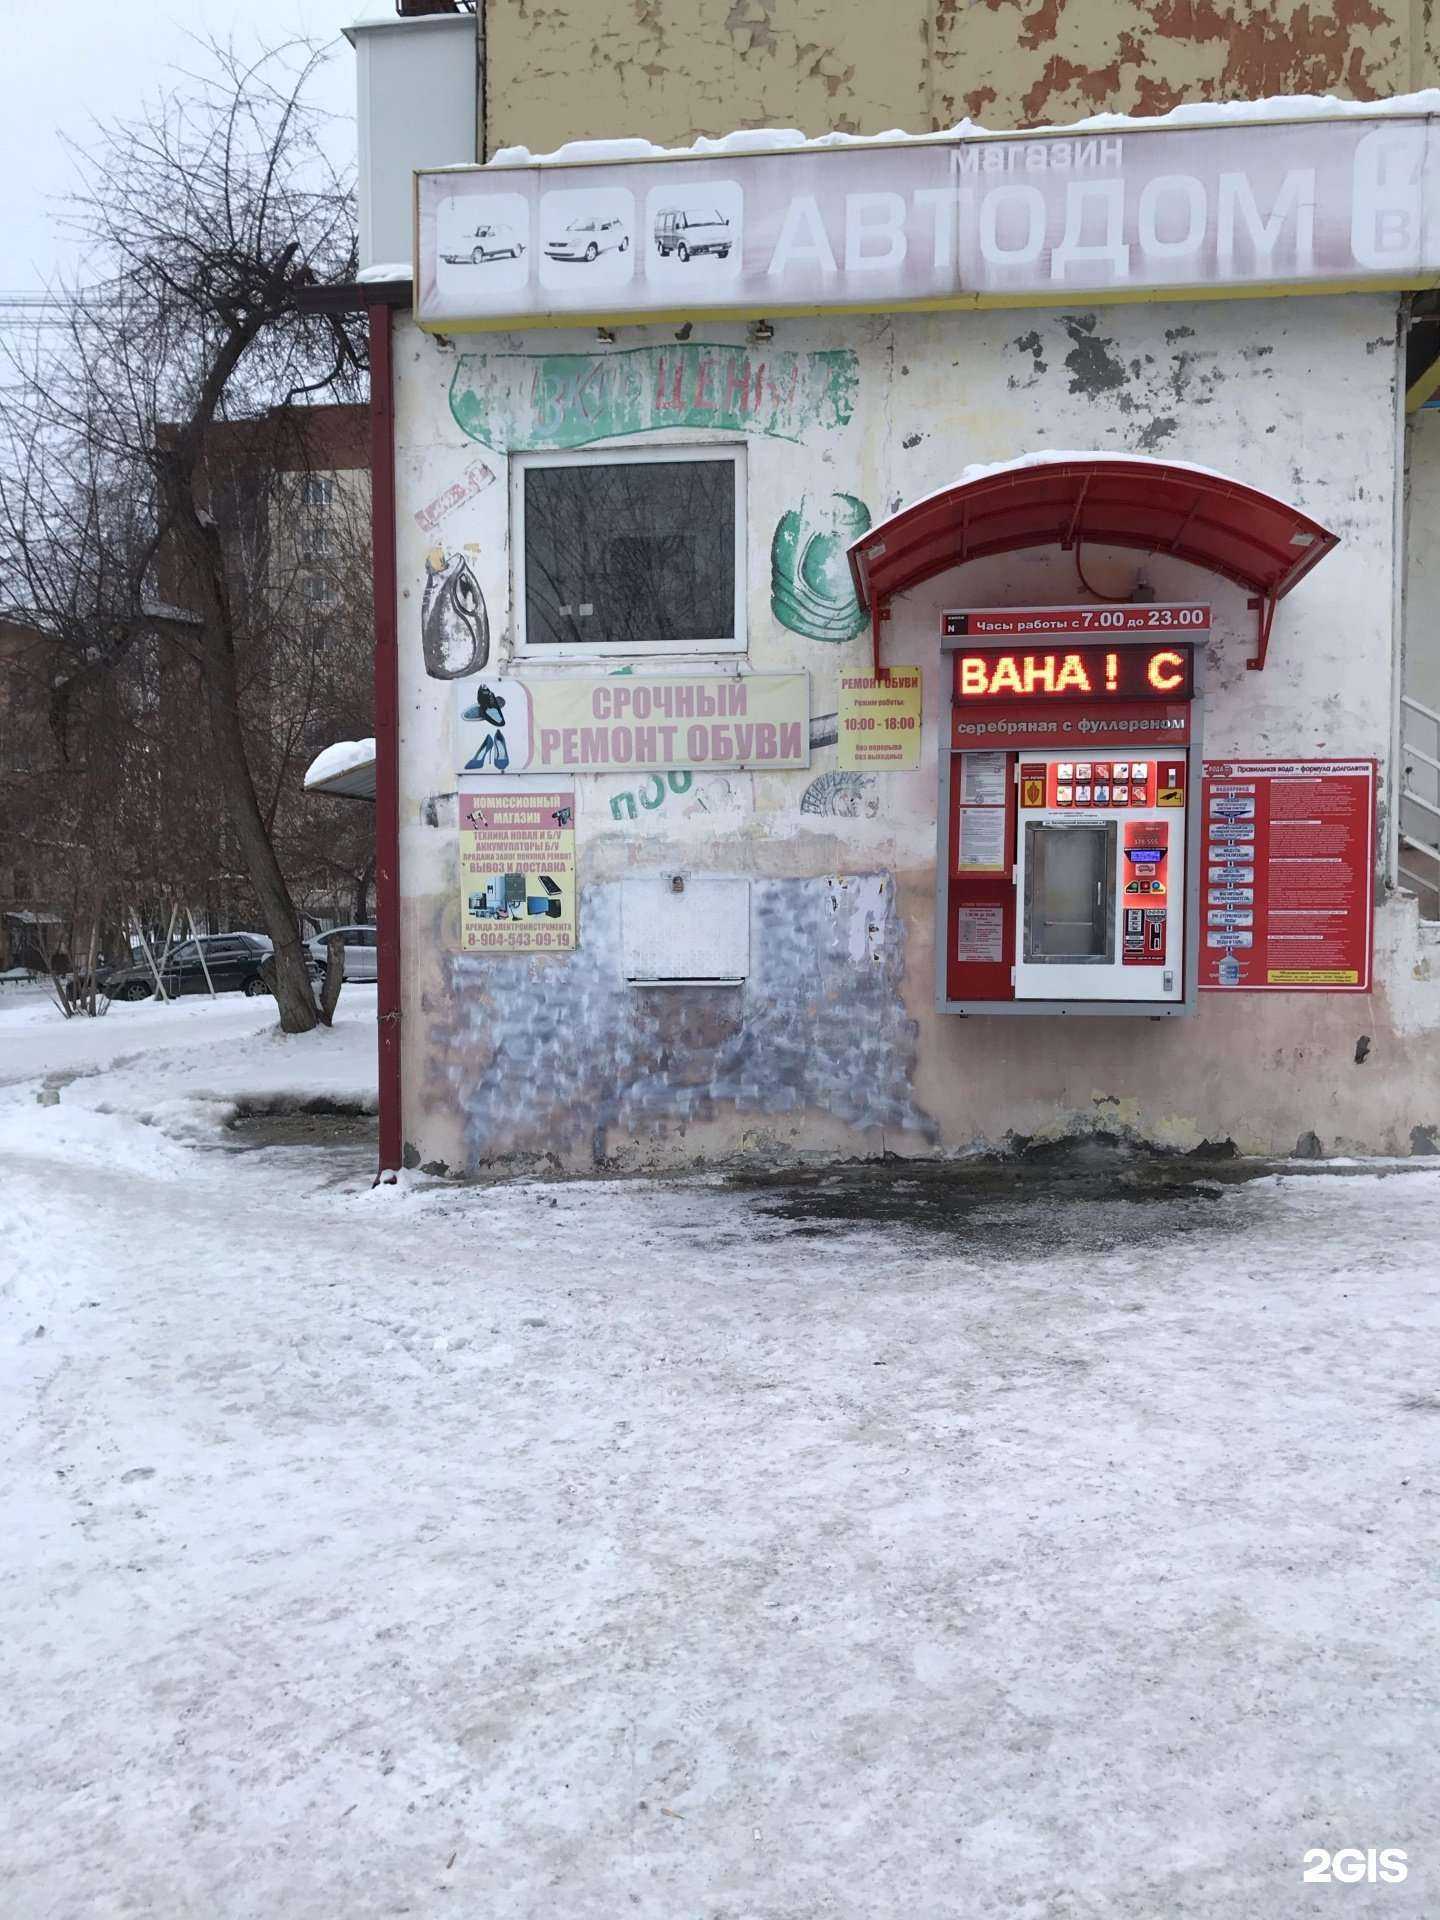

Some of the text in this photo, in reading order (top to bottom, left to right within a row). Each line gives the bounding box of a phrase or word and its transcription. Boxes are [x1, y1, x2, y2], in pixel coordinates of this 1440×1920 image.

[768, 168, 1317, 280] АВТОДОМ
[977, 621, 1013, 631] Часы
[1017, 619, 1068, 633] работы
[1072, 620, 1080, 628] с
[1082, 612, 1124, 627] 7.00
[1127, 618, 1144, 628] до
[1148, 610, 1203, 626] 23.00
[1148, 652, 1184, 689] С
[885, 676, 919, 688] ОБУВИ
[592, 683, 748, 721] СРОЧНЫЙ
[844, 718, 875, 730] 10:00
[885, 716, 915, 730] 18:00
[957, 717, 1186, 735] серебряная с фуллереном
[541, 721, 801, 766] РЕМОНТ ОБУВИ
[473, 794, 560, 808] КОМИССИОННЫЙ
[494, 812, 541, 823] МАГАЗИН
[475, 831, 508, 840] ТЕХНИКА
[511, 831, 536, 840] НОВАЯ
[476, 842, 544, 851] АККУМУЛЯТОРЫ
[470, 863, 505, 873] ВЫВОЗ
[515, 862, 566, 873] ДОСТАВКА
[467, 932, 570, 946] 8-904-543-09-19
